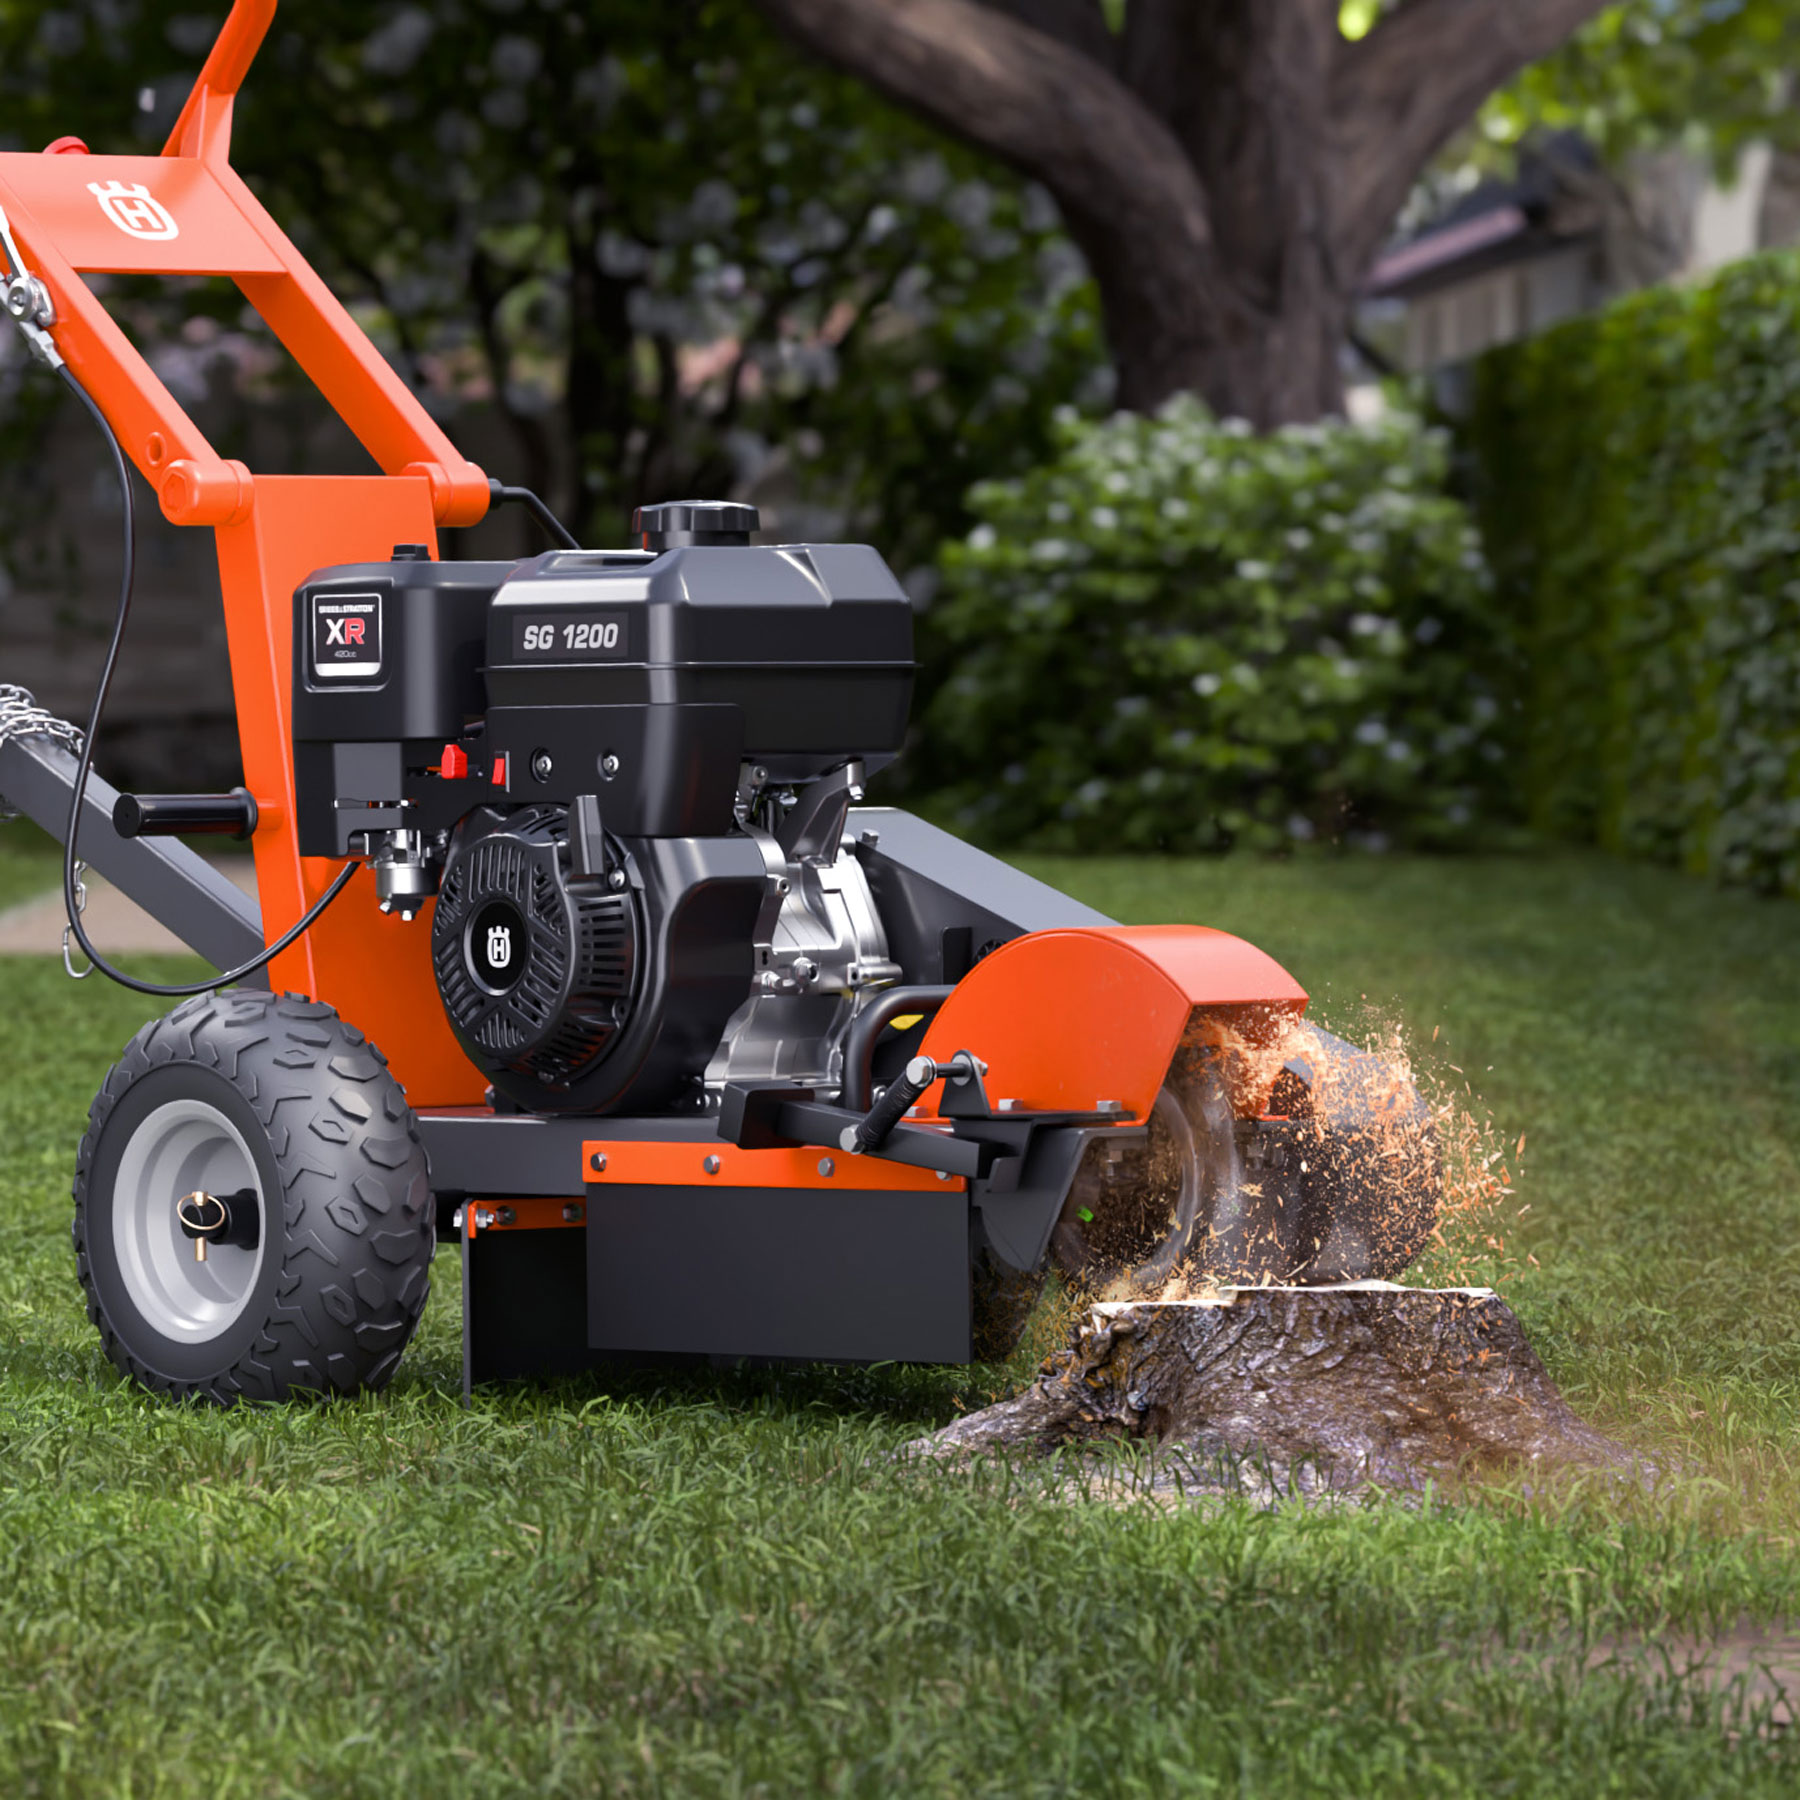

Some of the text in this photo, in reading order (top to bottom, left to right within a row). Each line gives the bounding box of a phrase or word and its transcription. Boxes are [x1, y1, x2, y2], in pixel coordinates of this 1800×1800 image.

[325, 617, 366, 646] XR
[523, 623, 619, 650] SG 1200
